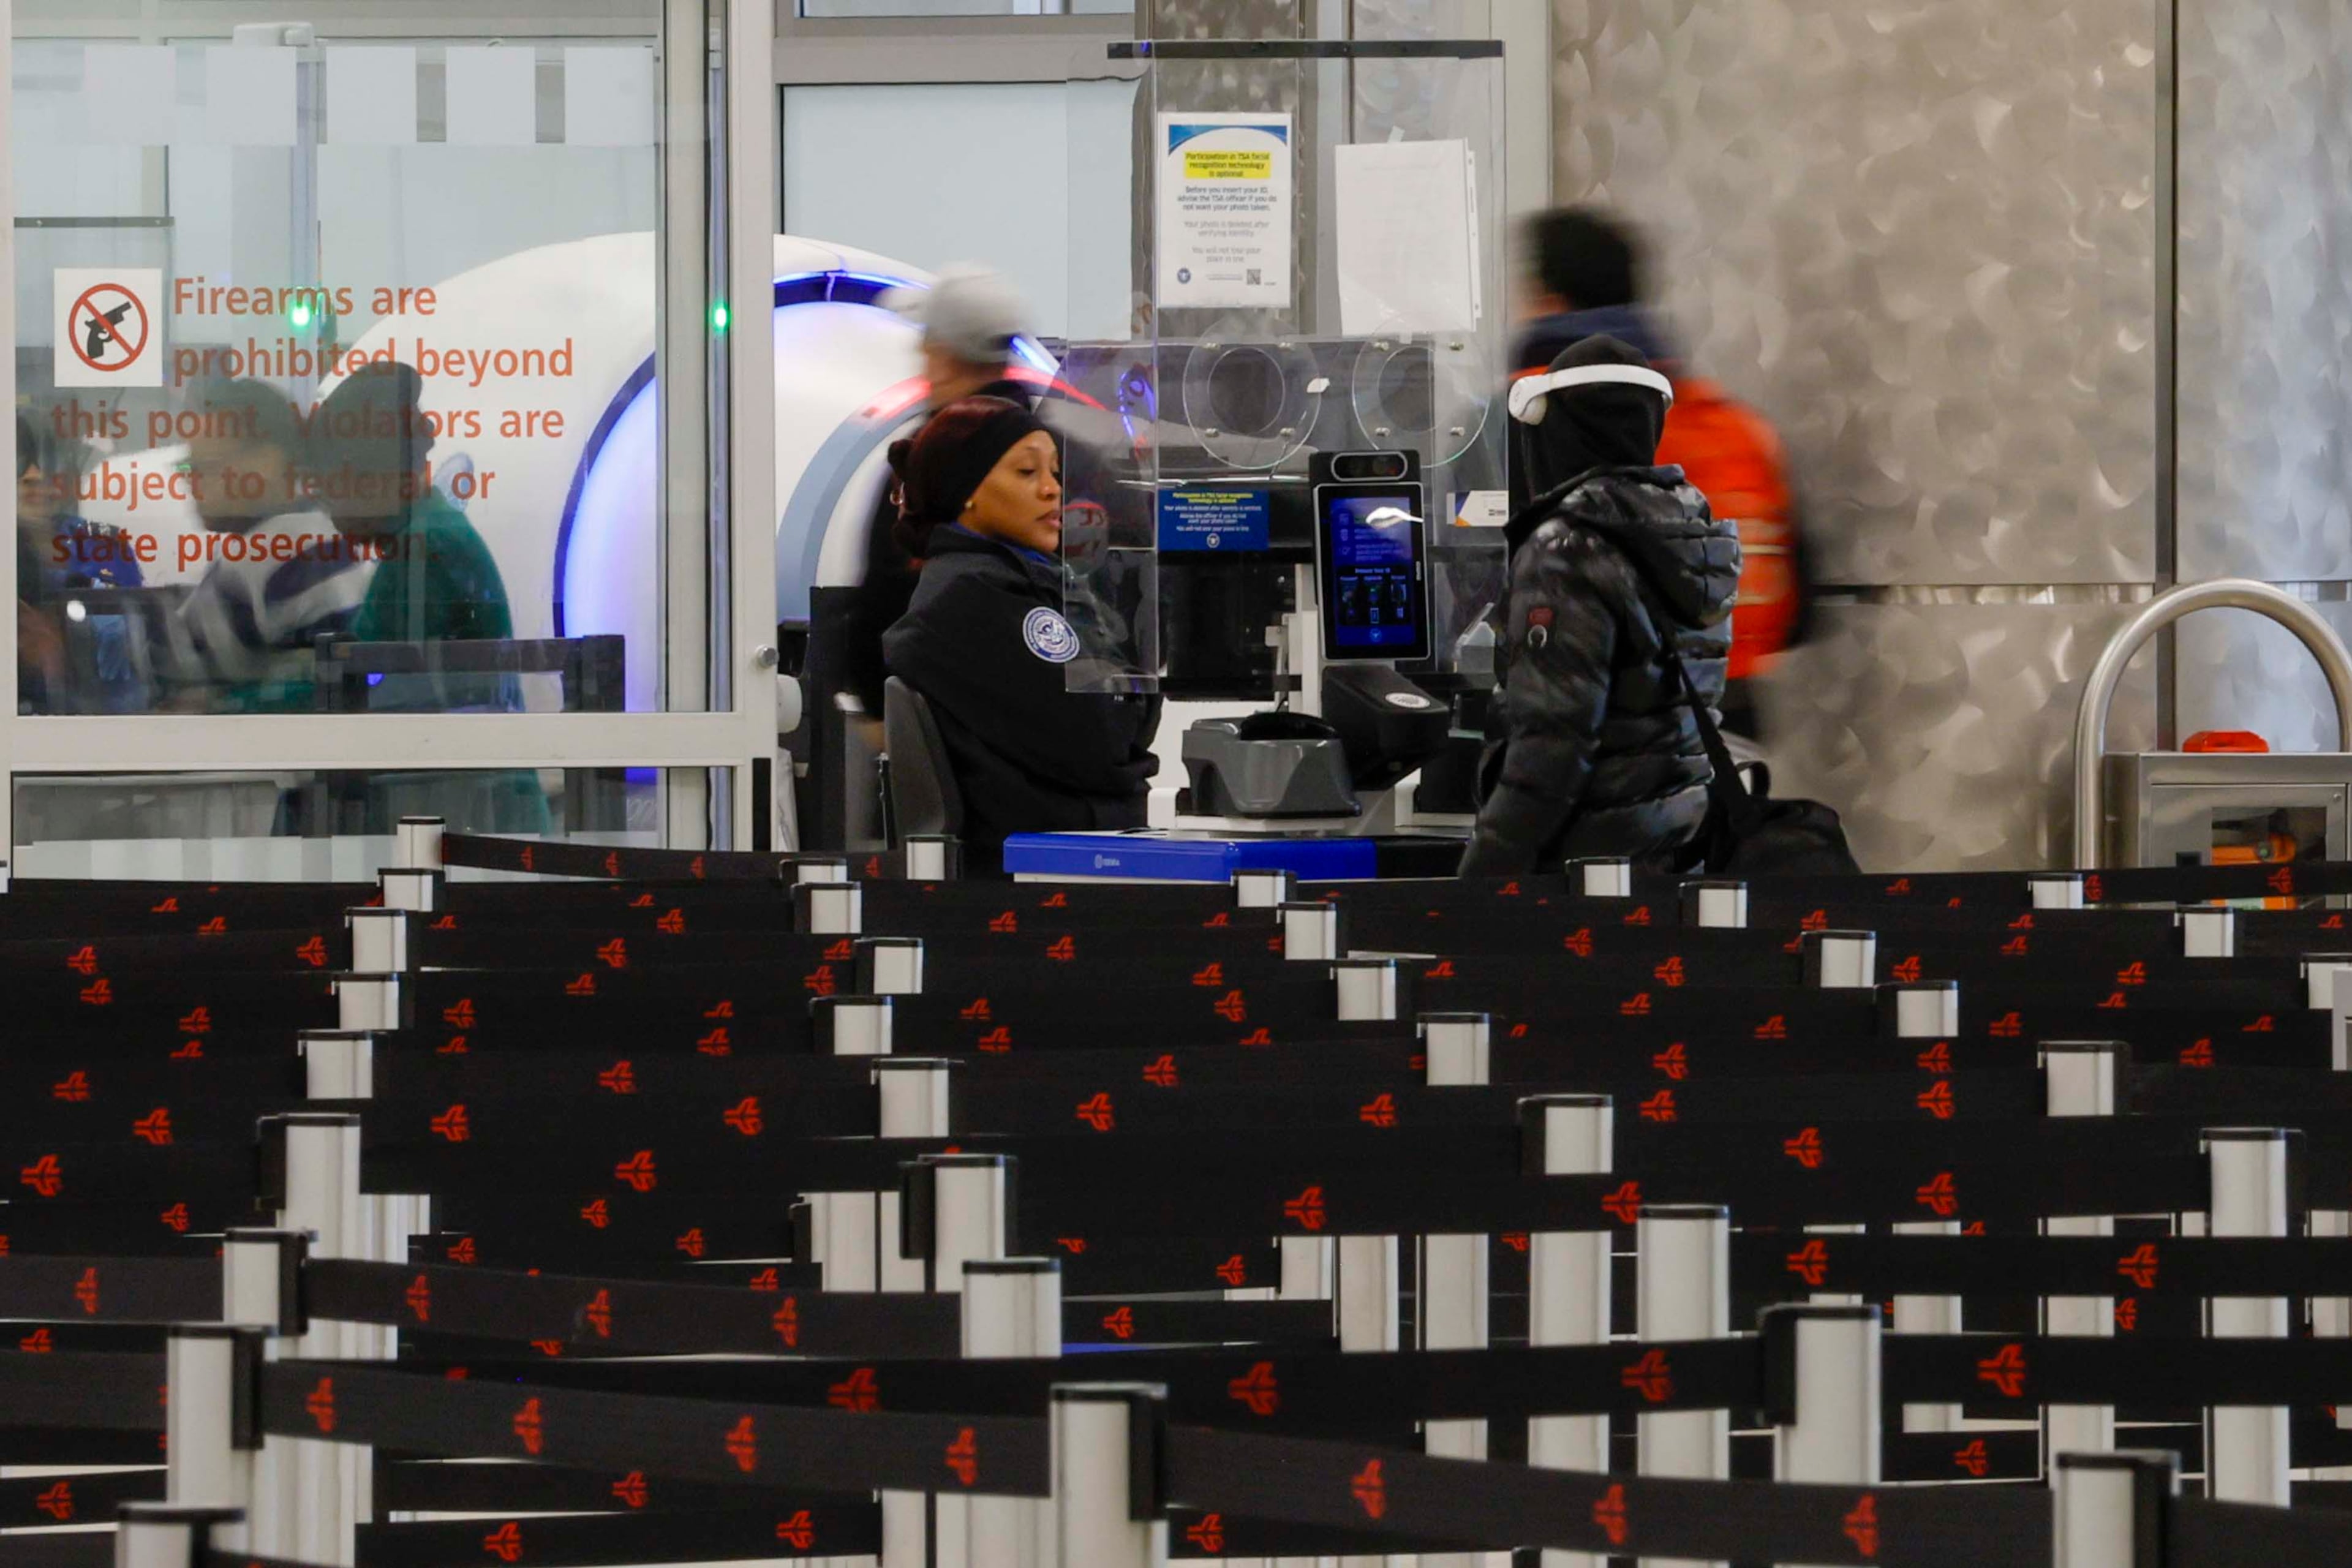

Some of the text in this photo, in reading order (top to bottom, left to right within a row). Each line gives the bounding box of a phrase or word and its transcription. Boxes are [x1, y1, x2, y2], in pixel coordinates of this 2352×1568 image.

[174, 277, 437, 316] Firearms are
[174, 337, 573, 388] prohibited beyond
[51, 399, 564, 449] this point. Violators are
[51, 460, 496, 511] subject to federal or
[51, 524, 439, 572] state prosecution.
